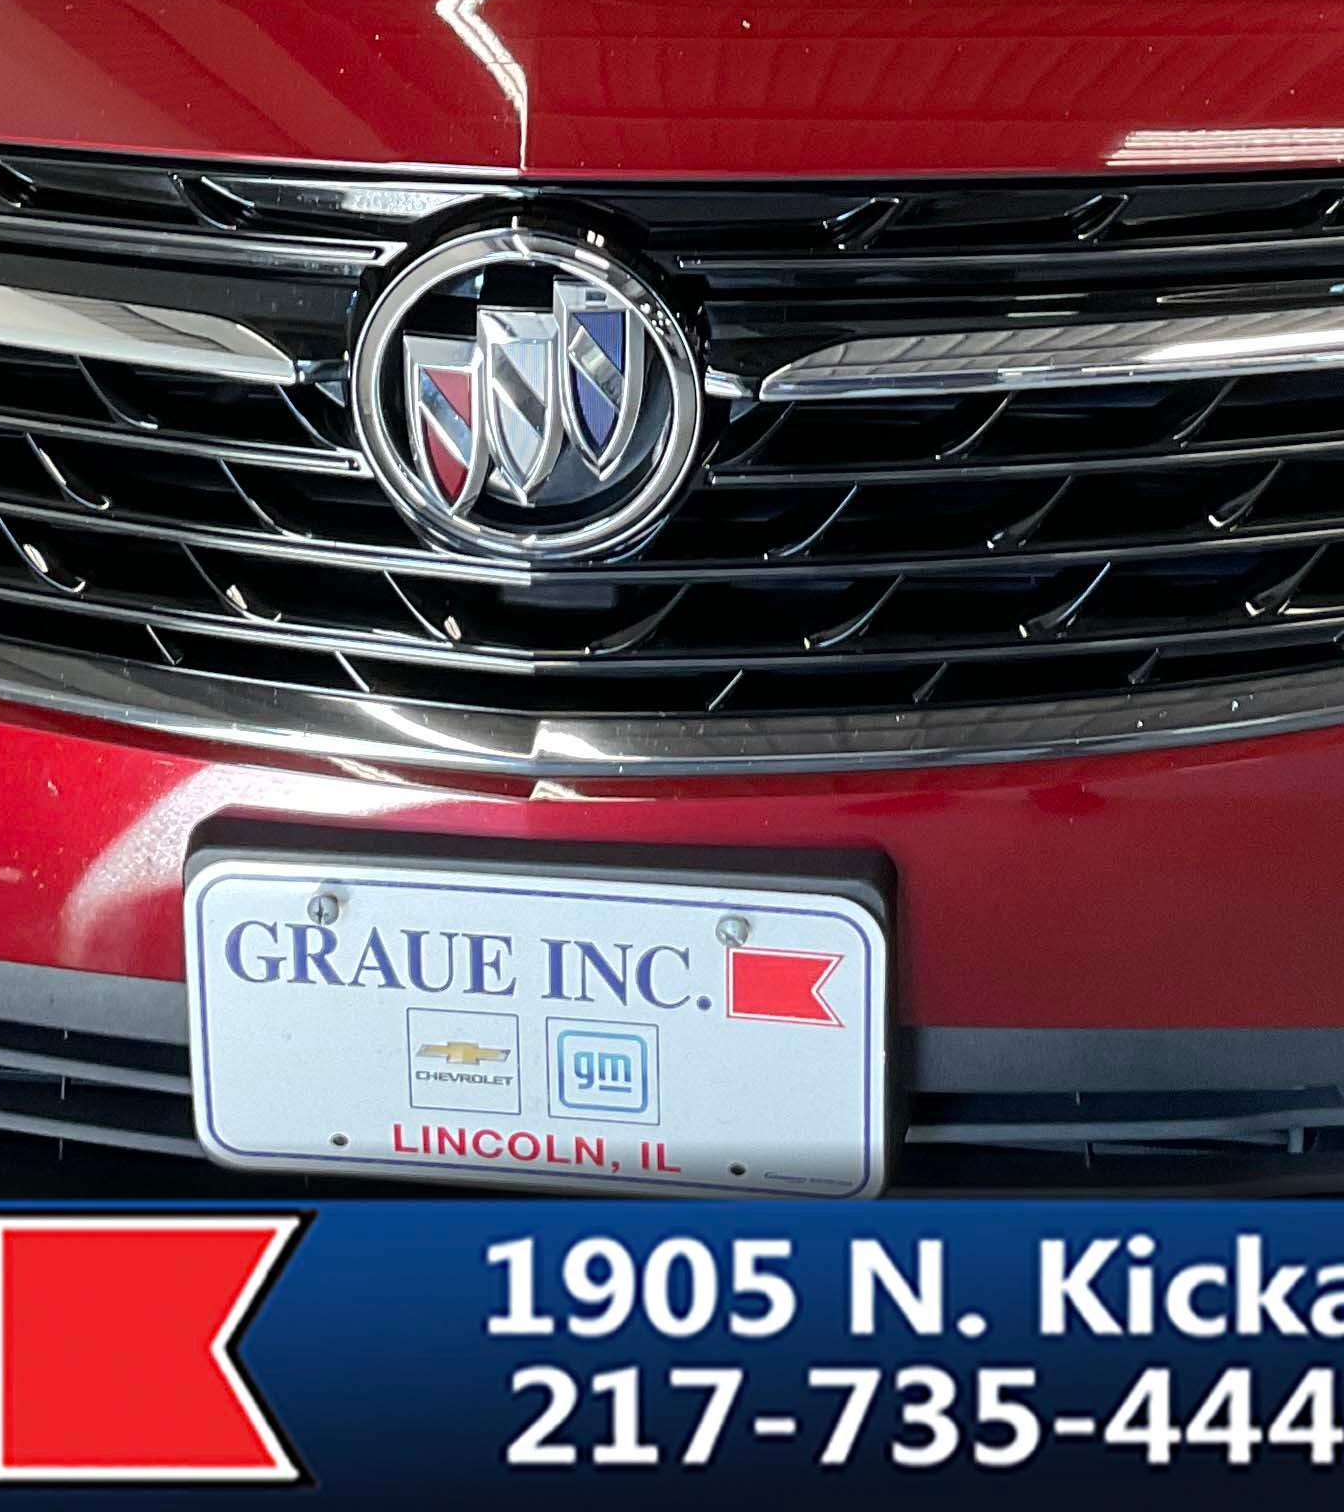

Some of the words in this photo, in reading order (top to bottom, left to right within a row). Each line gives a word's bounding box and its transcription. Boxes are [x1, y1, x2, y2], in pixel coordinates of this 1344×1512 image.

[224, 919, 517, 996] GRAUE
[540, 937, 713, 1011] INC.
[414, 1070, 514, 1087] CHEVROLET
[573, 1050, 633, 1090] gm
[391, 1122, 621, 1174] LINCOLN,
[640, 1141, 683, 1174] IL
